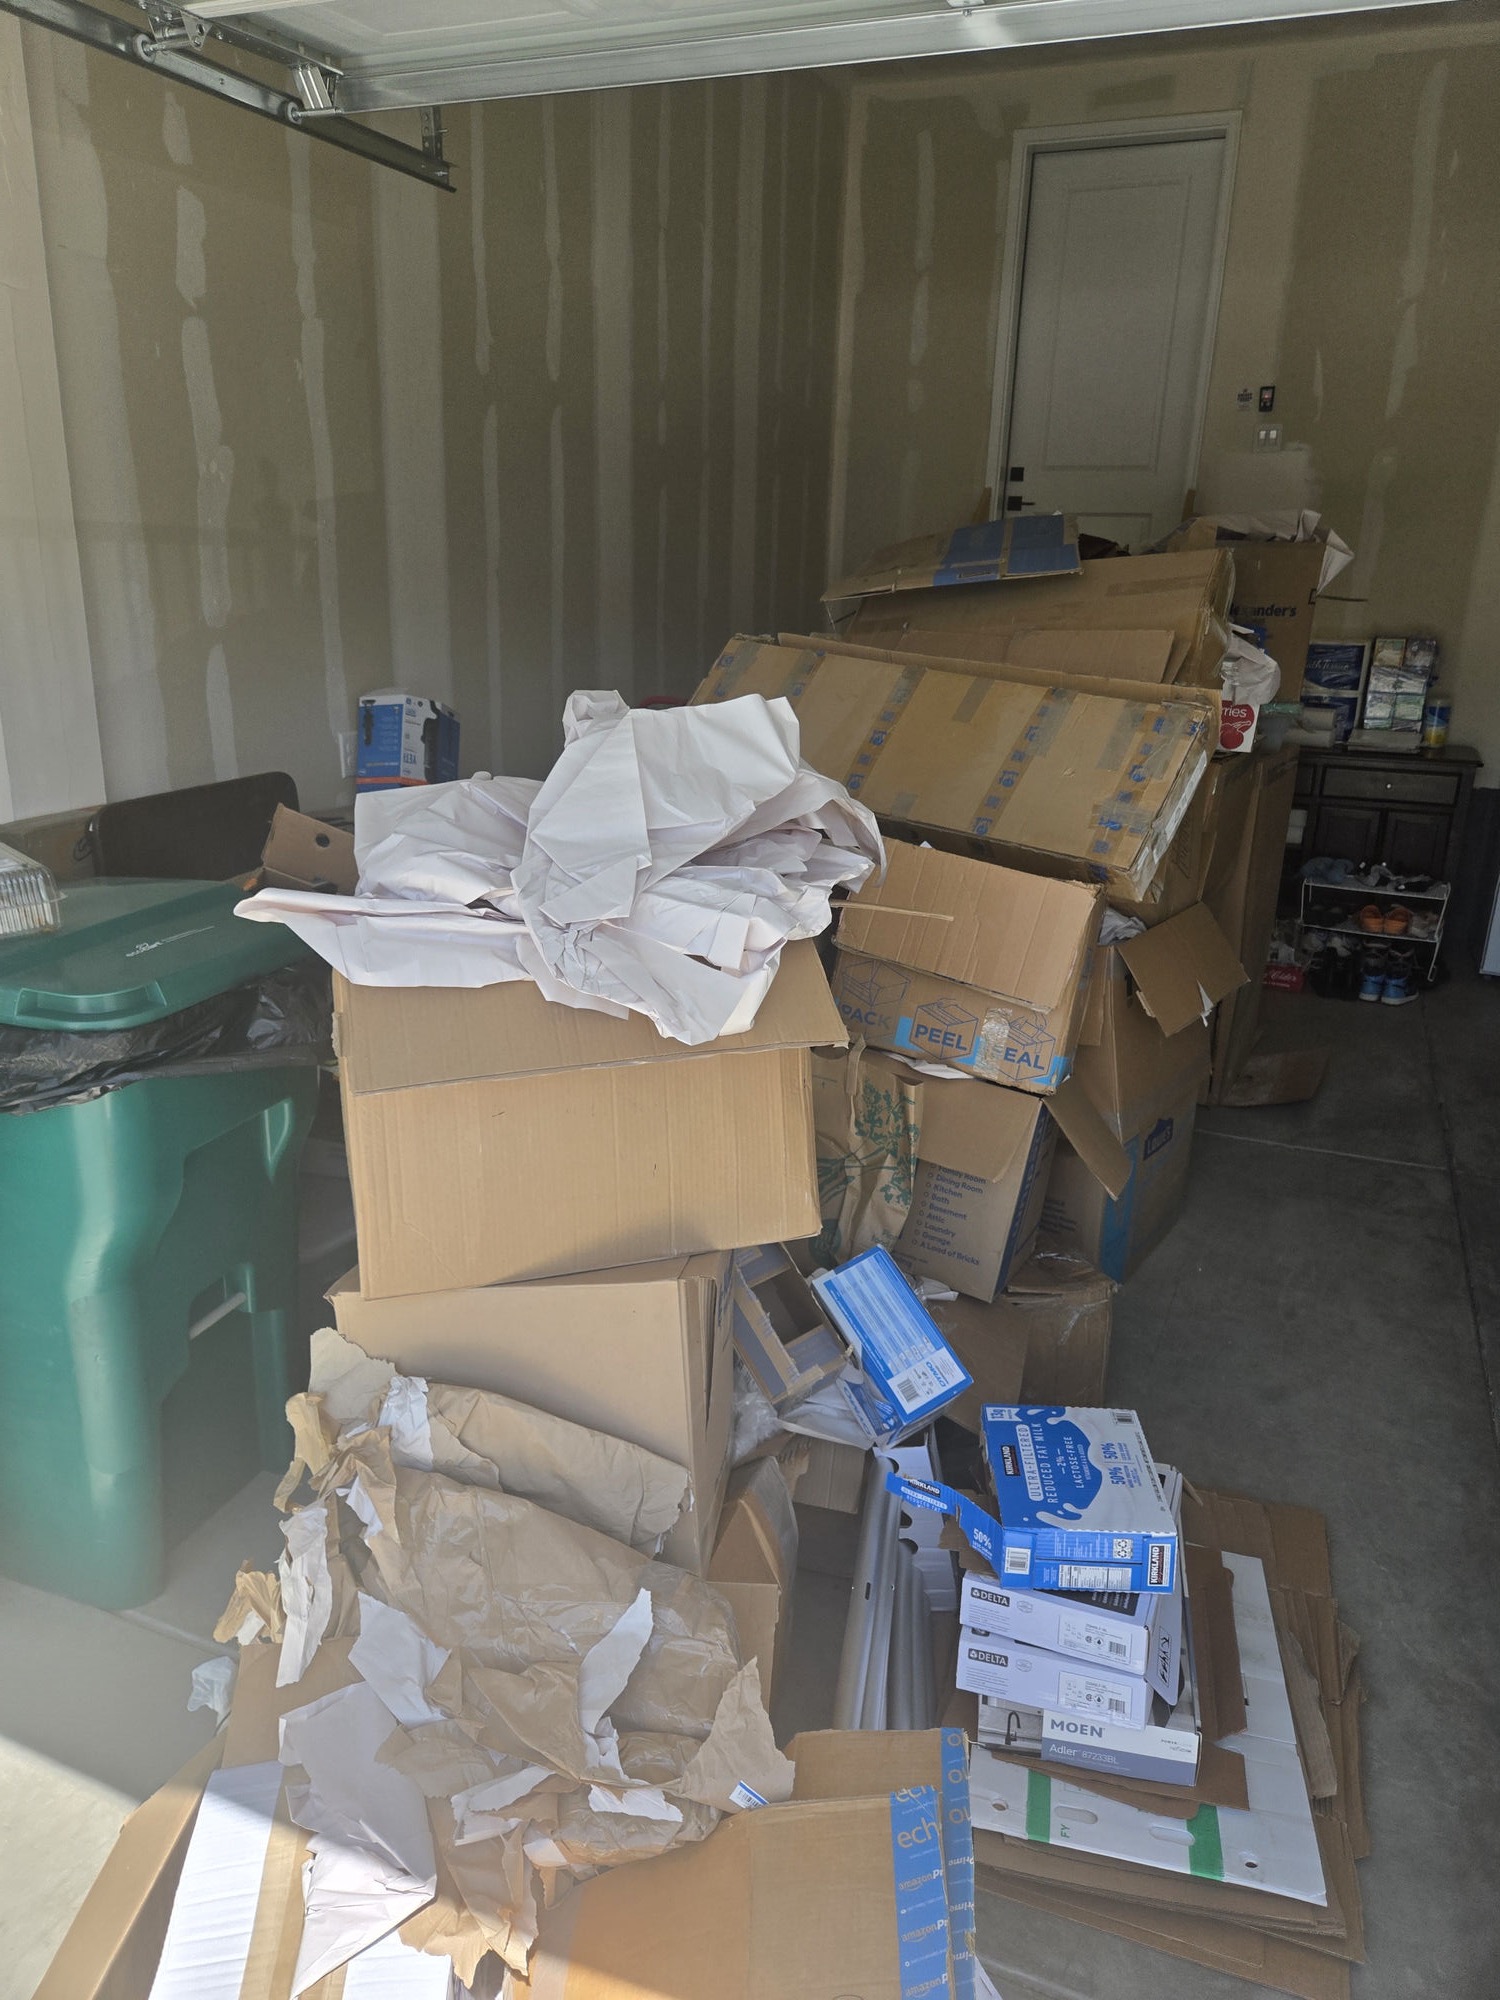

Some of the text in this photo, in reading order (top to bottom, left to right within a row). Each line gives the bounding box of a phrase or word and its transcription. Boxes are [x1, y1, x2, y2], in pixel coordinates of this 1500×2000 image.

[1222, 706, 1247, 718] ries
[915, 1024, 967, 1051] PEEL
[1001, 1046, 1045, 1070] EAL
[933, 1183, 963, 1198] Kitchen
[936, 1175, 984, 1194] Dining Room
[931, 1194, 950, 1205] Bath
[926, 1213, 945, 1224] Attic
[929, 1203, 967, 1221] Basement
[922, 1231, 950, 1246] Garage
[924, 1222, 956, 1238] Laundry
[926, 1243, 947, 1255] Load
[956, 1251, 980, 1266] Bricks
[926, 1361, 946, 1387] DYMO
[1102, 1442, 1118, 1460] 50%
[1002, 1446, 1014, 1475] KIRKLAND
[1018, 1427, 1041, 1497] ULTRA-FILTERED
[1031, 1423, 1059, 1503] REDUCED FAT MILK
[1063, 1437, 1084, 1488] LACTOSE-FREE
[1109, 1467, 1125, 1485] 50%
[909, 1480, 940, 1494] KIRKLAND
[973, 1528, 992, 1549] 50%
[1151, 1547, 1159, 1583] KIRKLAND
[980, 1591, 1009, 1606] DELTA
[978, 1651, 1008, 1667] DELTA
[1051, 1719, 1103, 1738] MOEN
[1049, 1744, 1077, 1757] Adler
